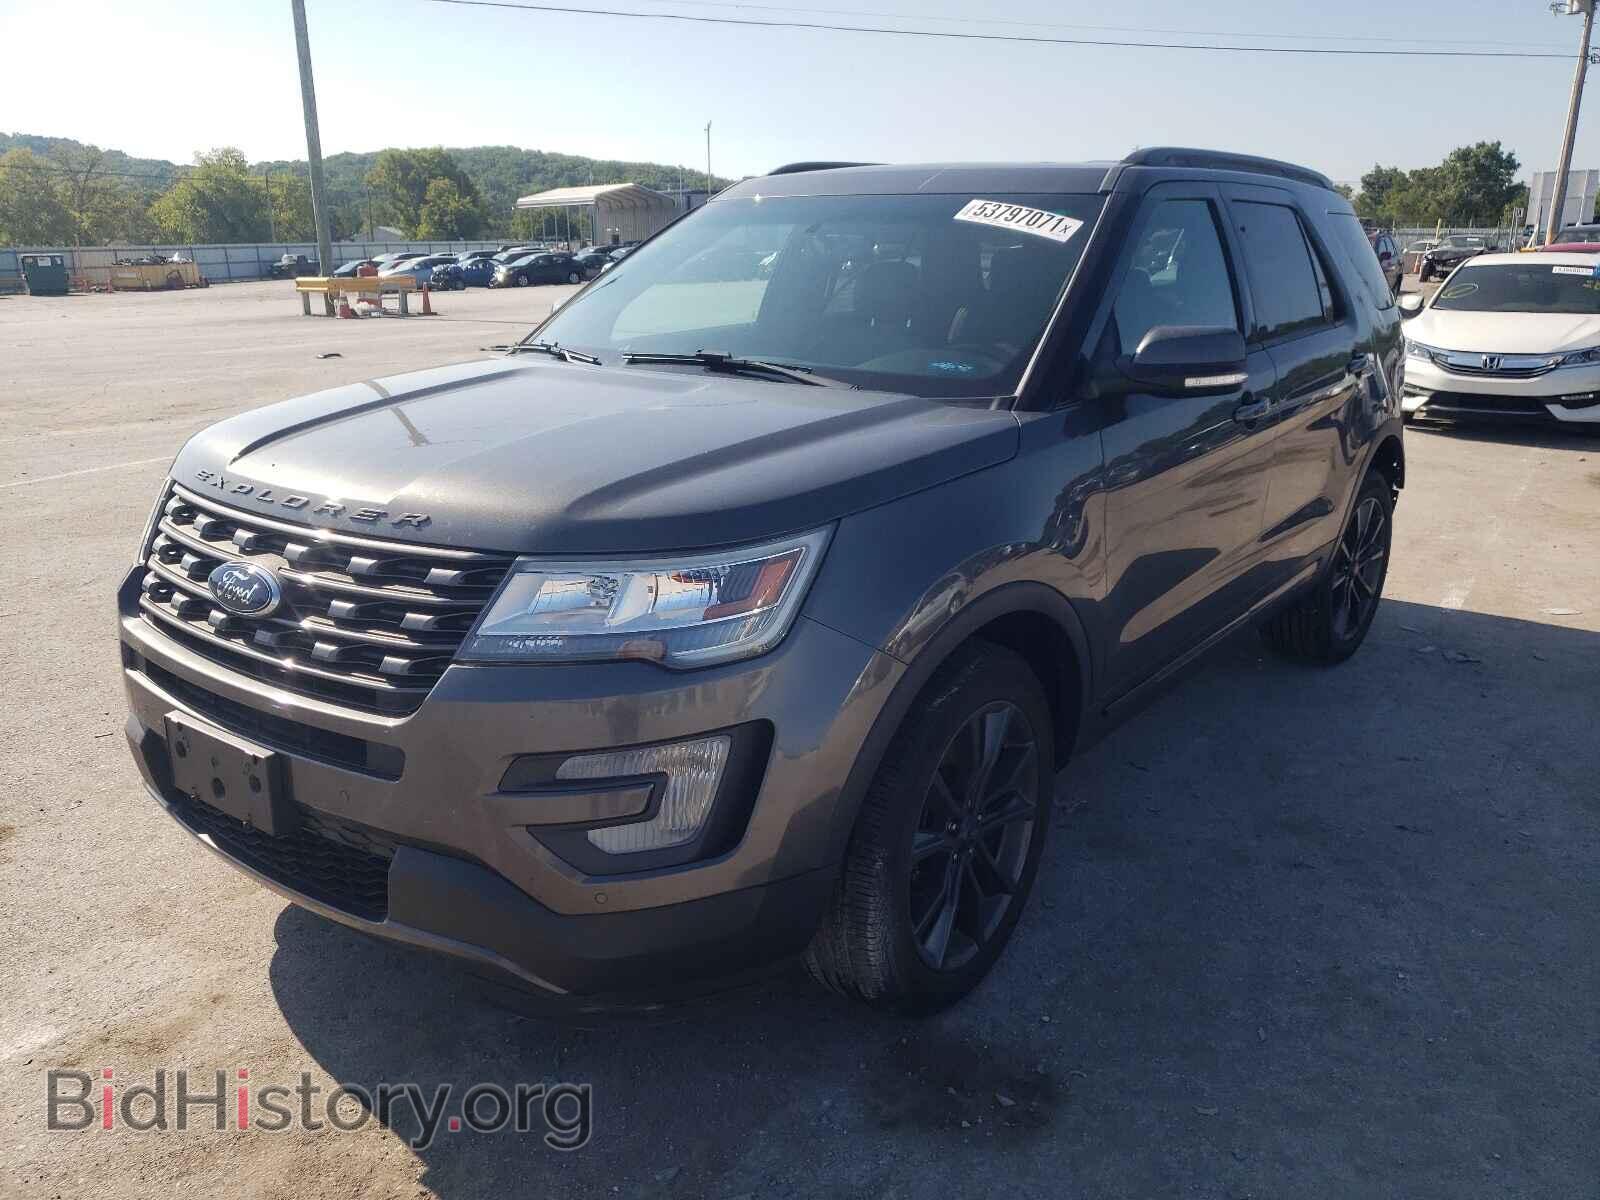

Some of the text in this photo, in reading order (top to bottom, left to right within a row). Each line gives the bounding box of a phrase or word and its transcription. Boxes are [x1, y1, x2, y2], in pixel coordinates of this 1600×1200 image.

[973, 202, 1064, 232] 53797071
[194, 469, 432, 527] EXPLORER
[217, 570, 259, 604] Ford
